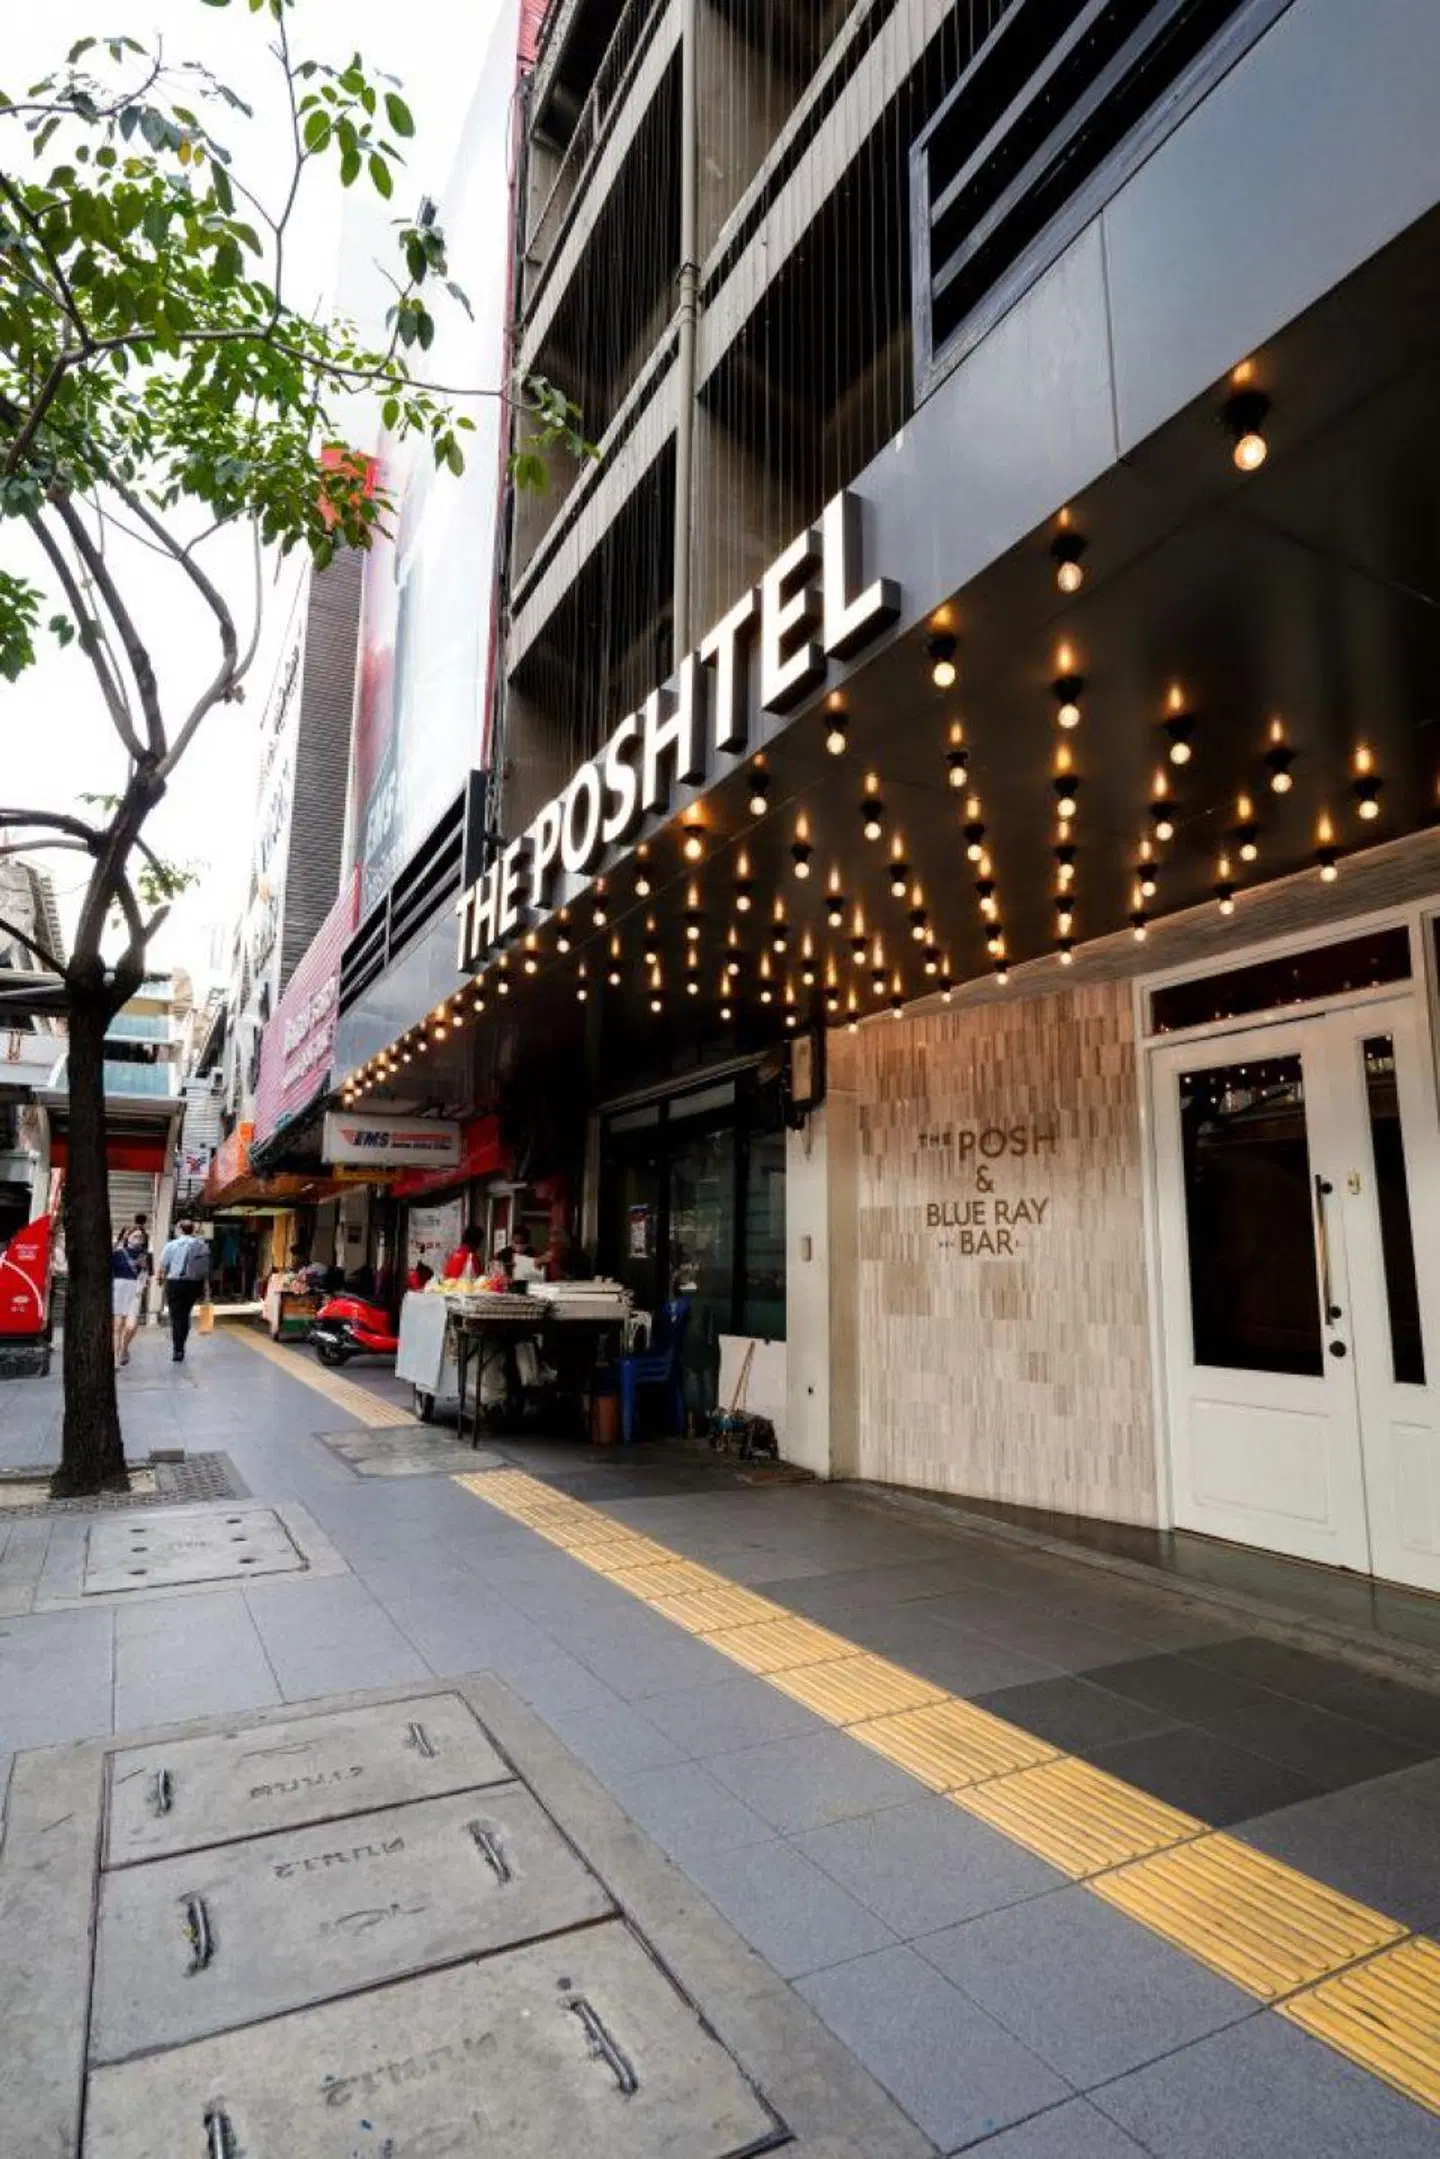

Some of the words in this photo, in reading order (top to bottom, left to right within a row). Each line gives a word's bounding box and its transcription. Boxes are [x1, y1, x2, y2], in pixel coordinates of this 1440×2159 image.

[456, 838, 528, 973] THE
[530, 490, 892, 908] POSHTEL
[353, 1130, 391, 1147] EMS
[919, 1131, 952, 1148] THE
[958, 1124, 1056, 1161] POSH
[976, 1165, 995, 1193] &
[926, 1200, 987, 1227] BLUE
[994, 1197, 1050, 1225] RAY
[960, 1229, 1014, 1256] BAR
